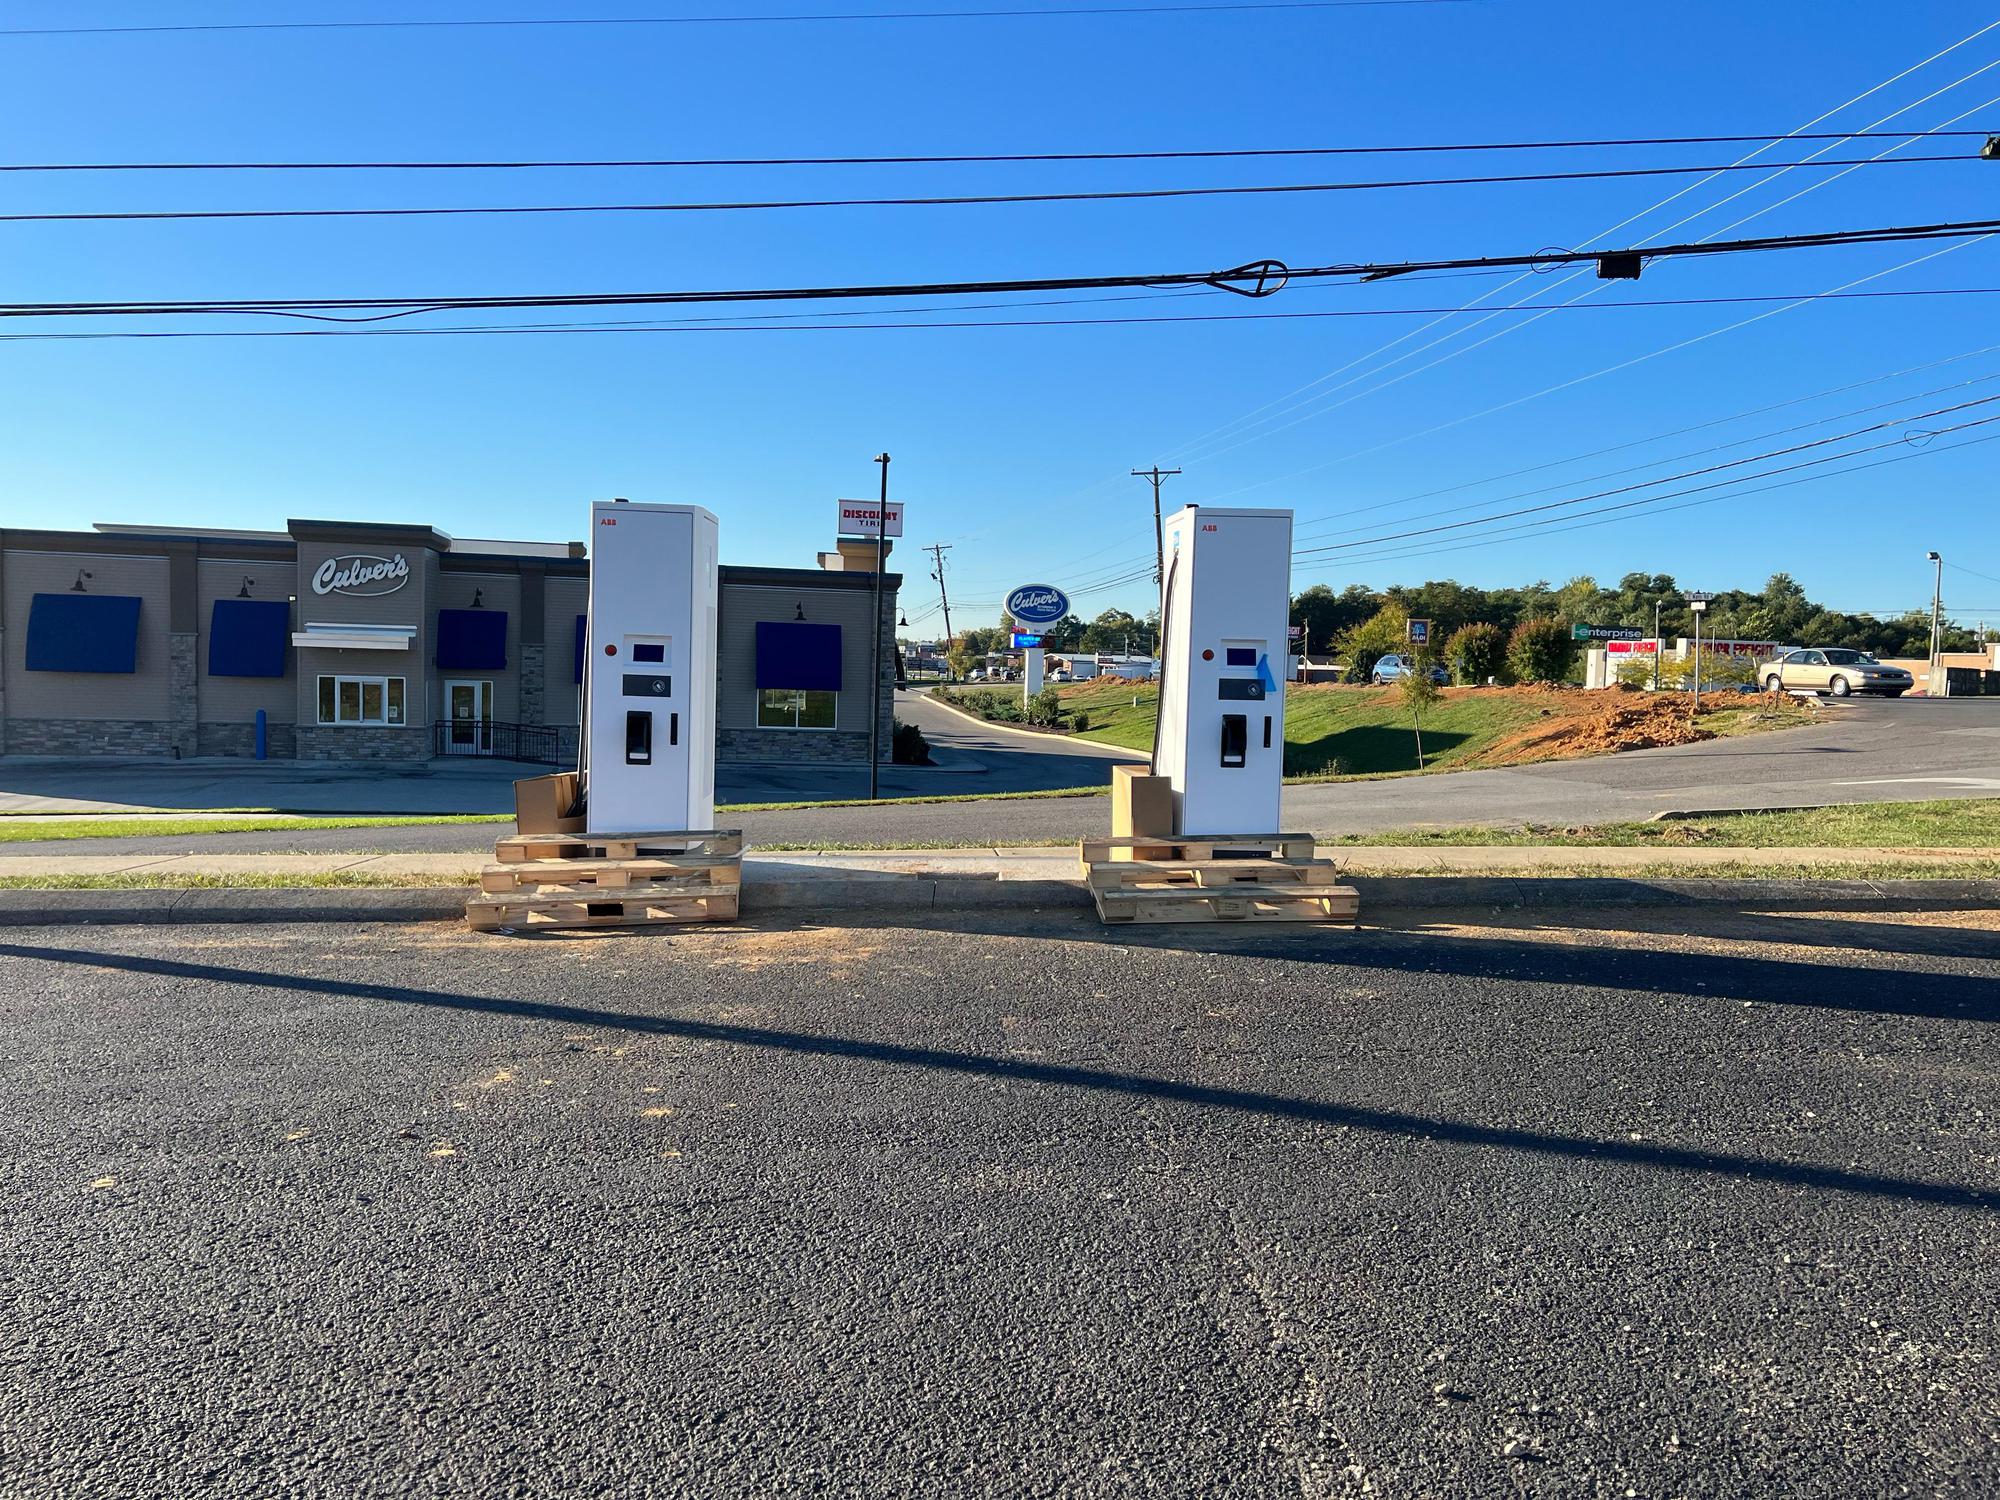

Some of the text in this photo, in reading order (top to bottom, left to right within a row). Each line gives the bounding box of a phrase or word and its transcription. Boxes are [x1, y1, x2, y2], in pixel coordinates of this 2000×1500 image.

[843, 509, 898, 521] DISCOUNT
[600, 518, 617, 526] ABB
[1202, 524, 1218, 532] ABB
[312, 554, 410, 595] Culver's
[1010, 590, 1060, 612] Culver's
[1577, 628, 1642, 639] enterprise
